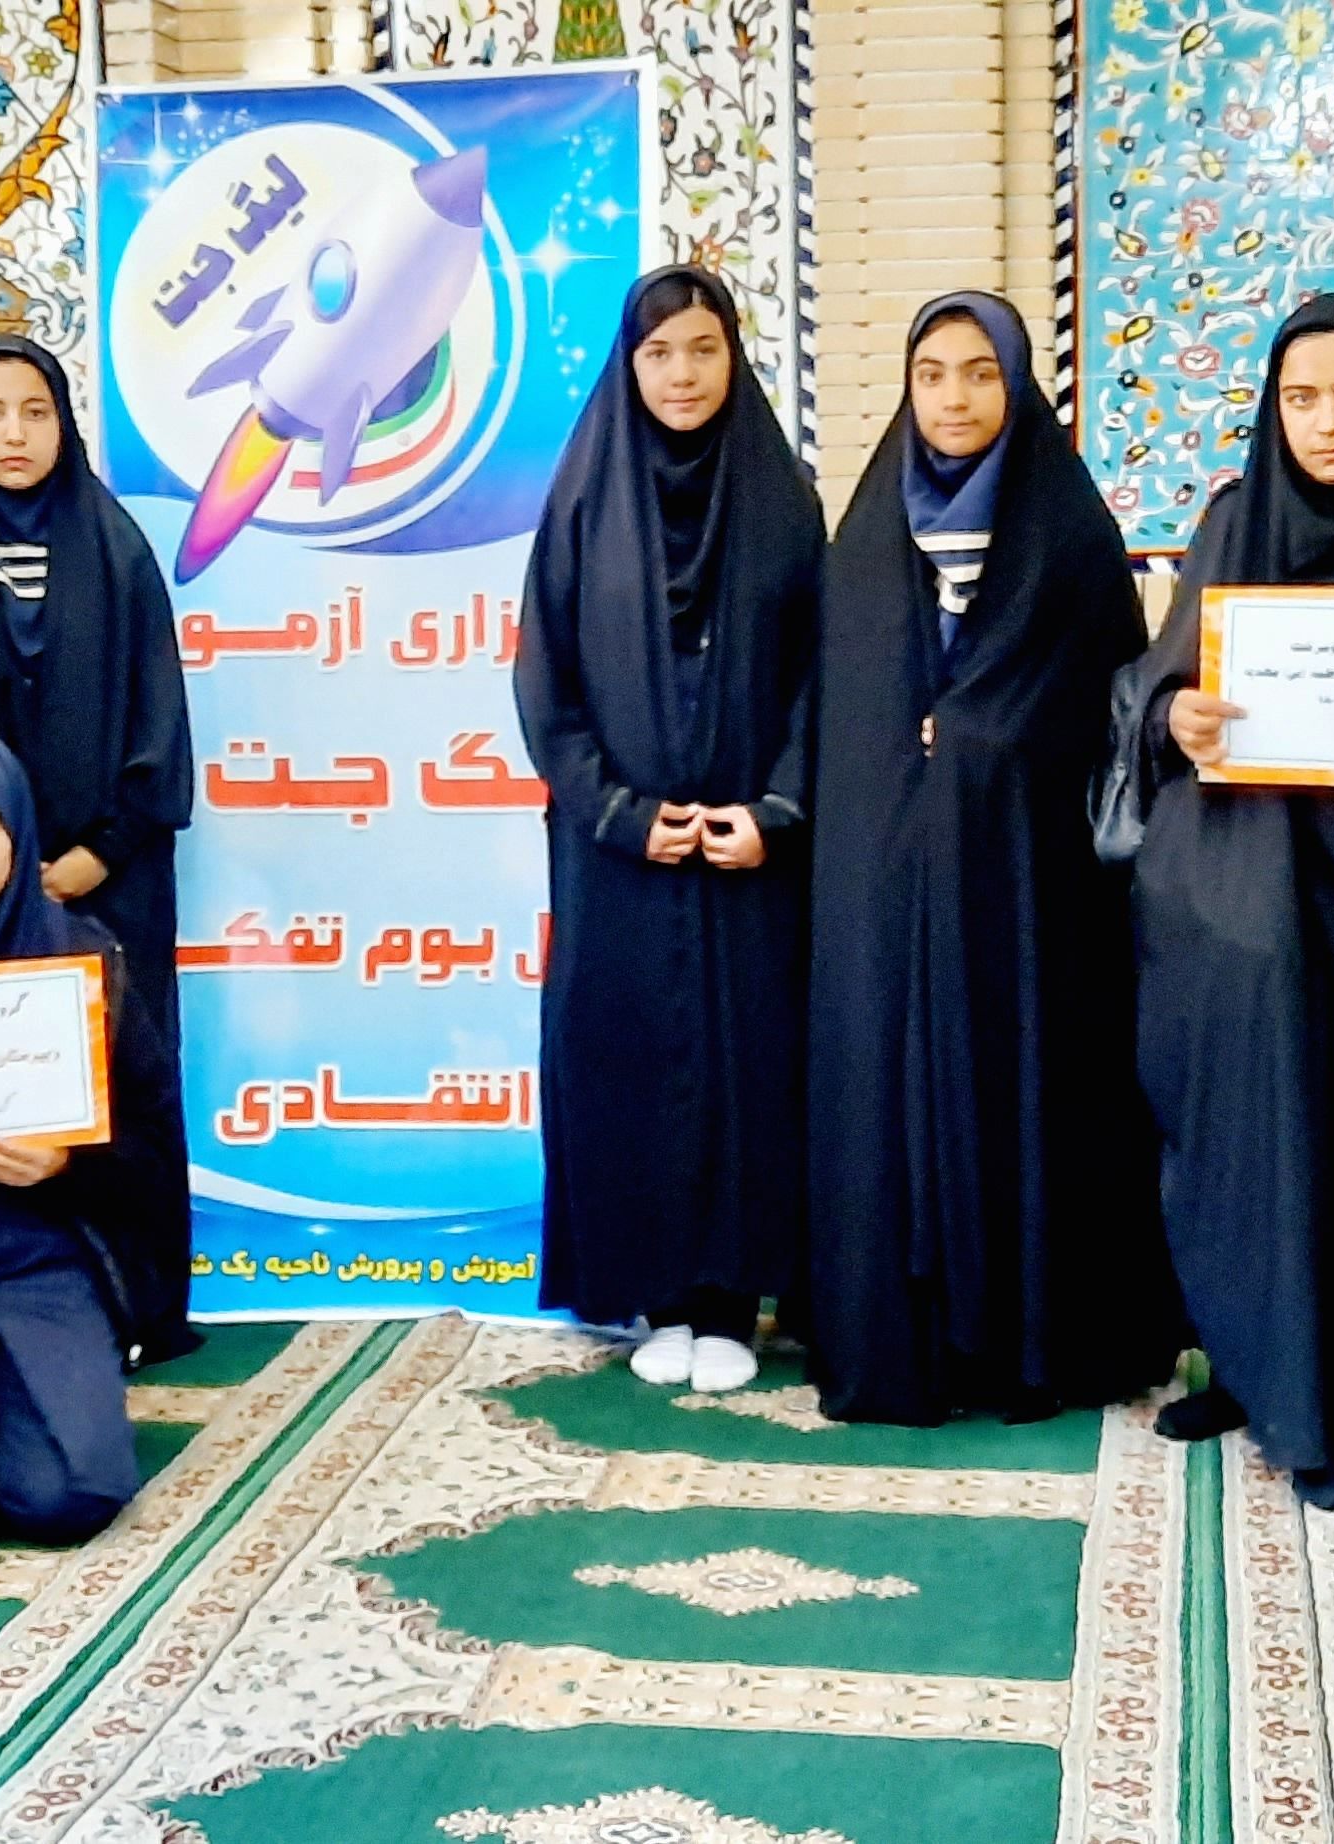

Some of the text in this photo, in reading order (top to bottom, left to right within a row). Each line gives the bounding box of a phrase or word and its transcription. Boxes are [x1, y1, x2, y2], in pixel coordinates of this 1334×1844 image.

[152, 153, 308, 330] لیگ جت
[181, 587, 521, 668] زاری آزمو
[205, 741, 390, 825] جت
[175, 911, 343, 968] تفک
[365, 926, 495, 982] بوم
[221, 1068, 532, 1139] انتقادی
[221, 1251, 257, 1280] یک
[265, 1251, 331, 1281] ناحیه
[338, 1253, 423, 1283] پرورش
[429, 1259, 445, 1281] و
[452, 1253, 536, 1283] آموزش
